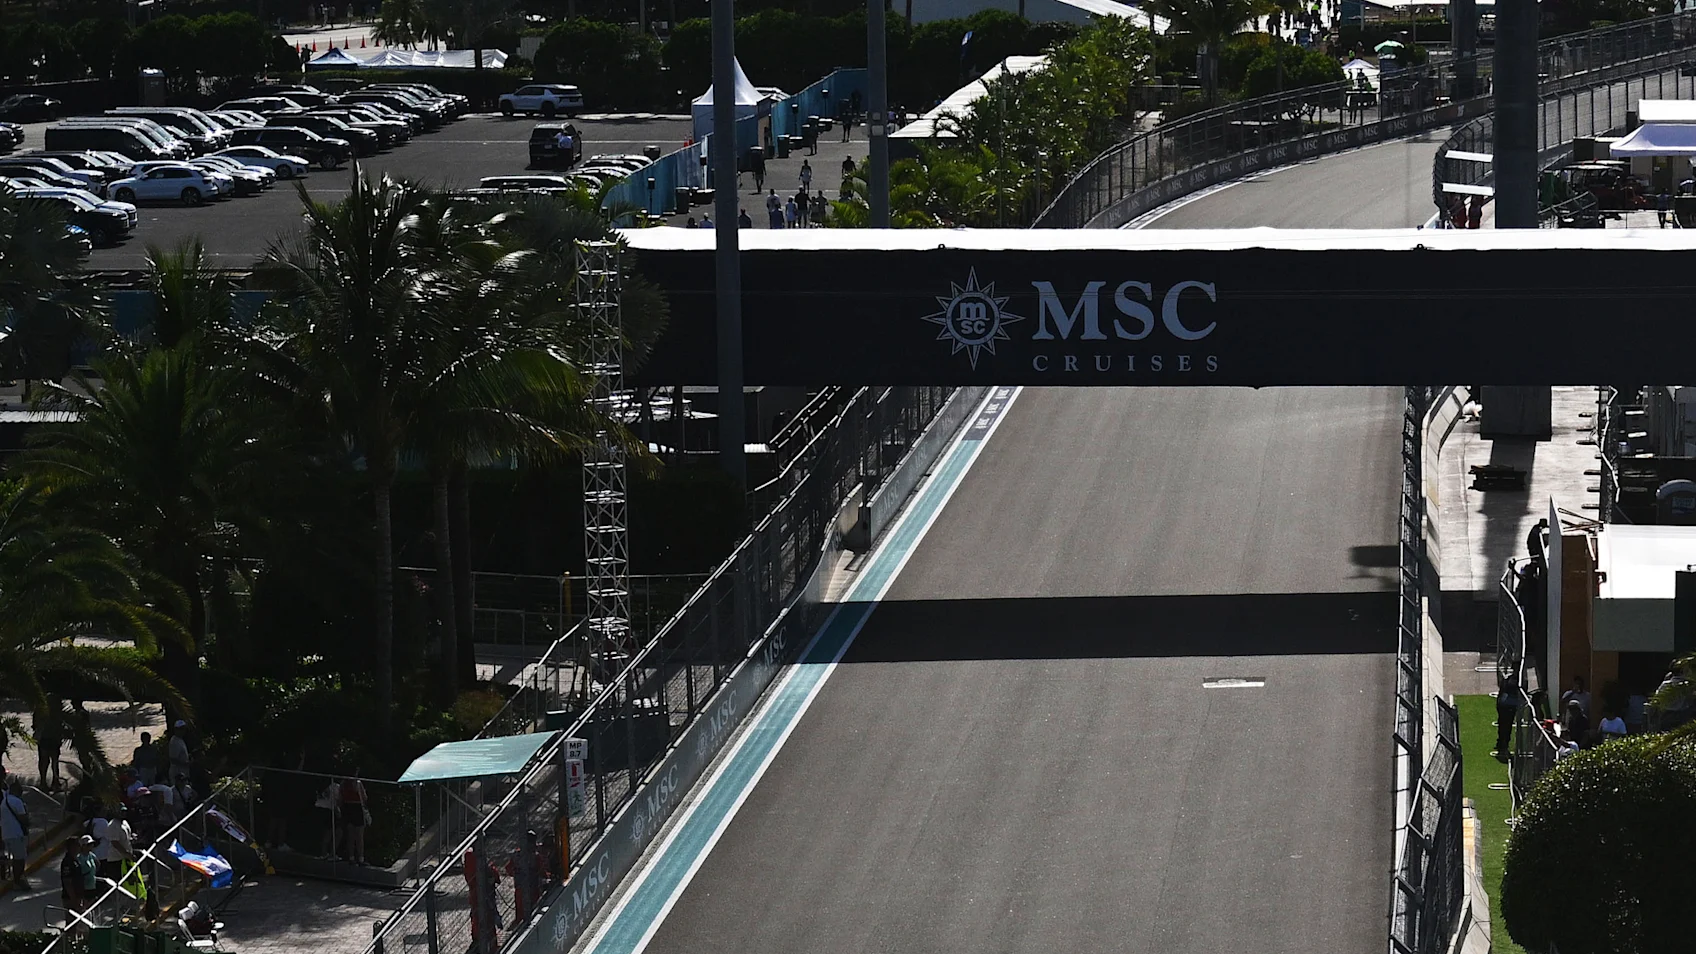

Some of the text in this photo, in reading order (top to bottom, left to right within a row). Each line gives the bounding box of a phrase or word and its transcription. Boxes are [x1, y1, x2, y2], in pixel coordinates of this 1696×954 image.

[1031, 279, 1218, 342] MSC
[1032, 353, 1219, 373] CRUISES
[763, 625, 788, 670] MSC
[709, 689, 738, 741] MSC
[569, 742, 582, 750] MP
[569, 750, 581, 758] 8.7
[646, 764, 680, 823] MSC
[571, 851, 610, 921] MSC
